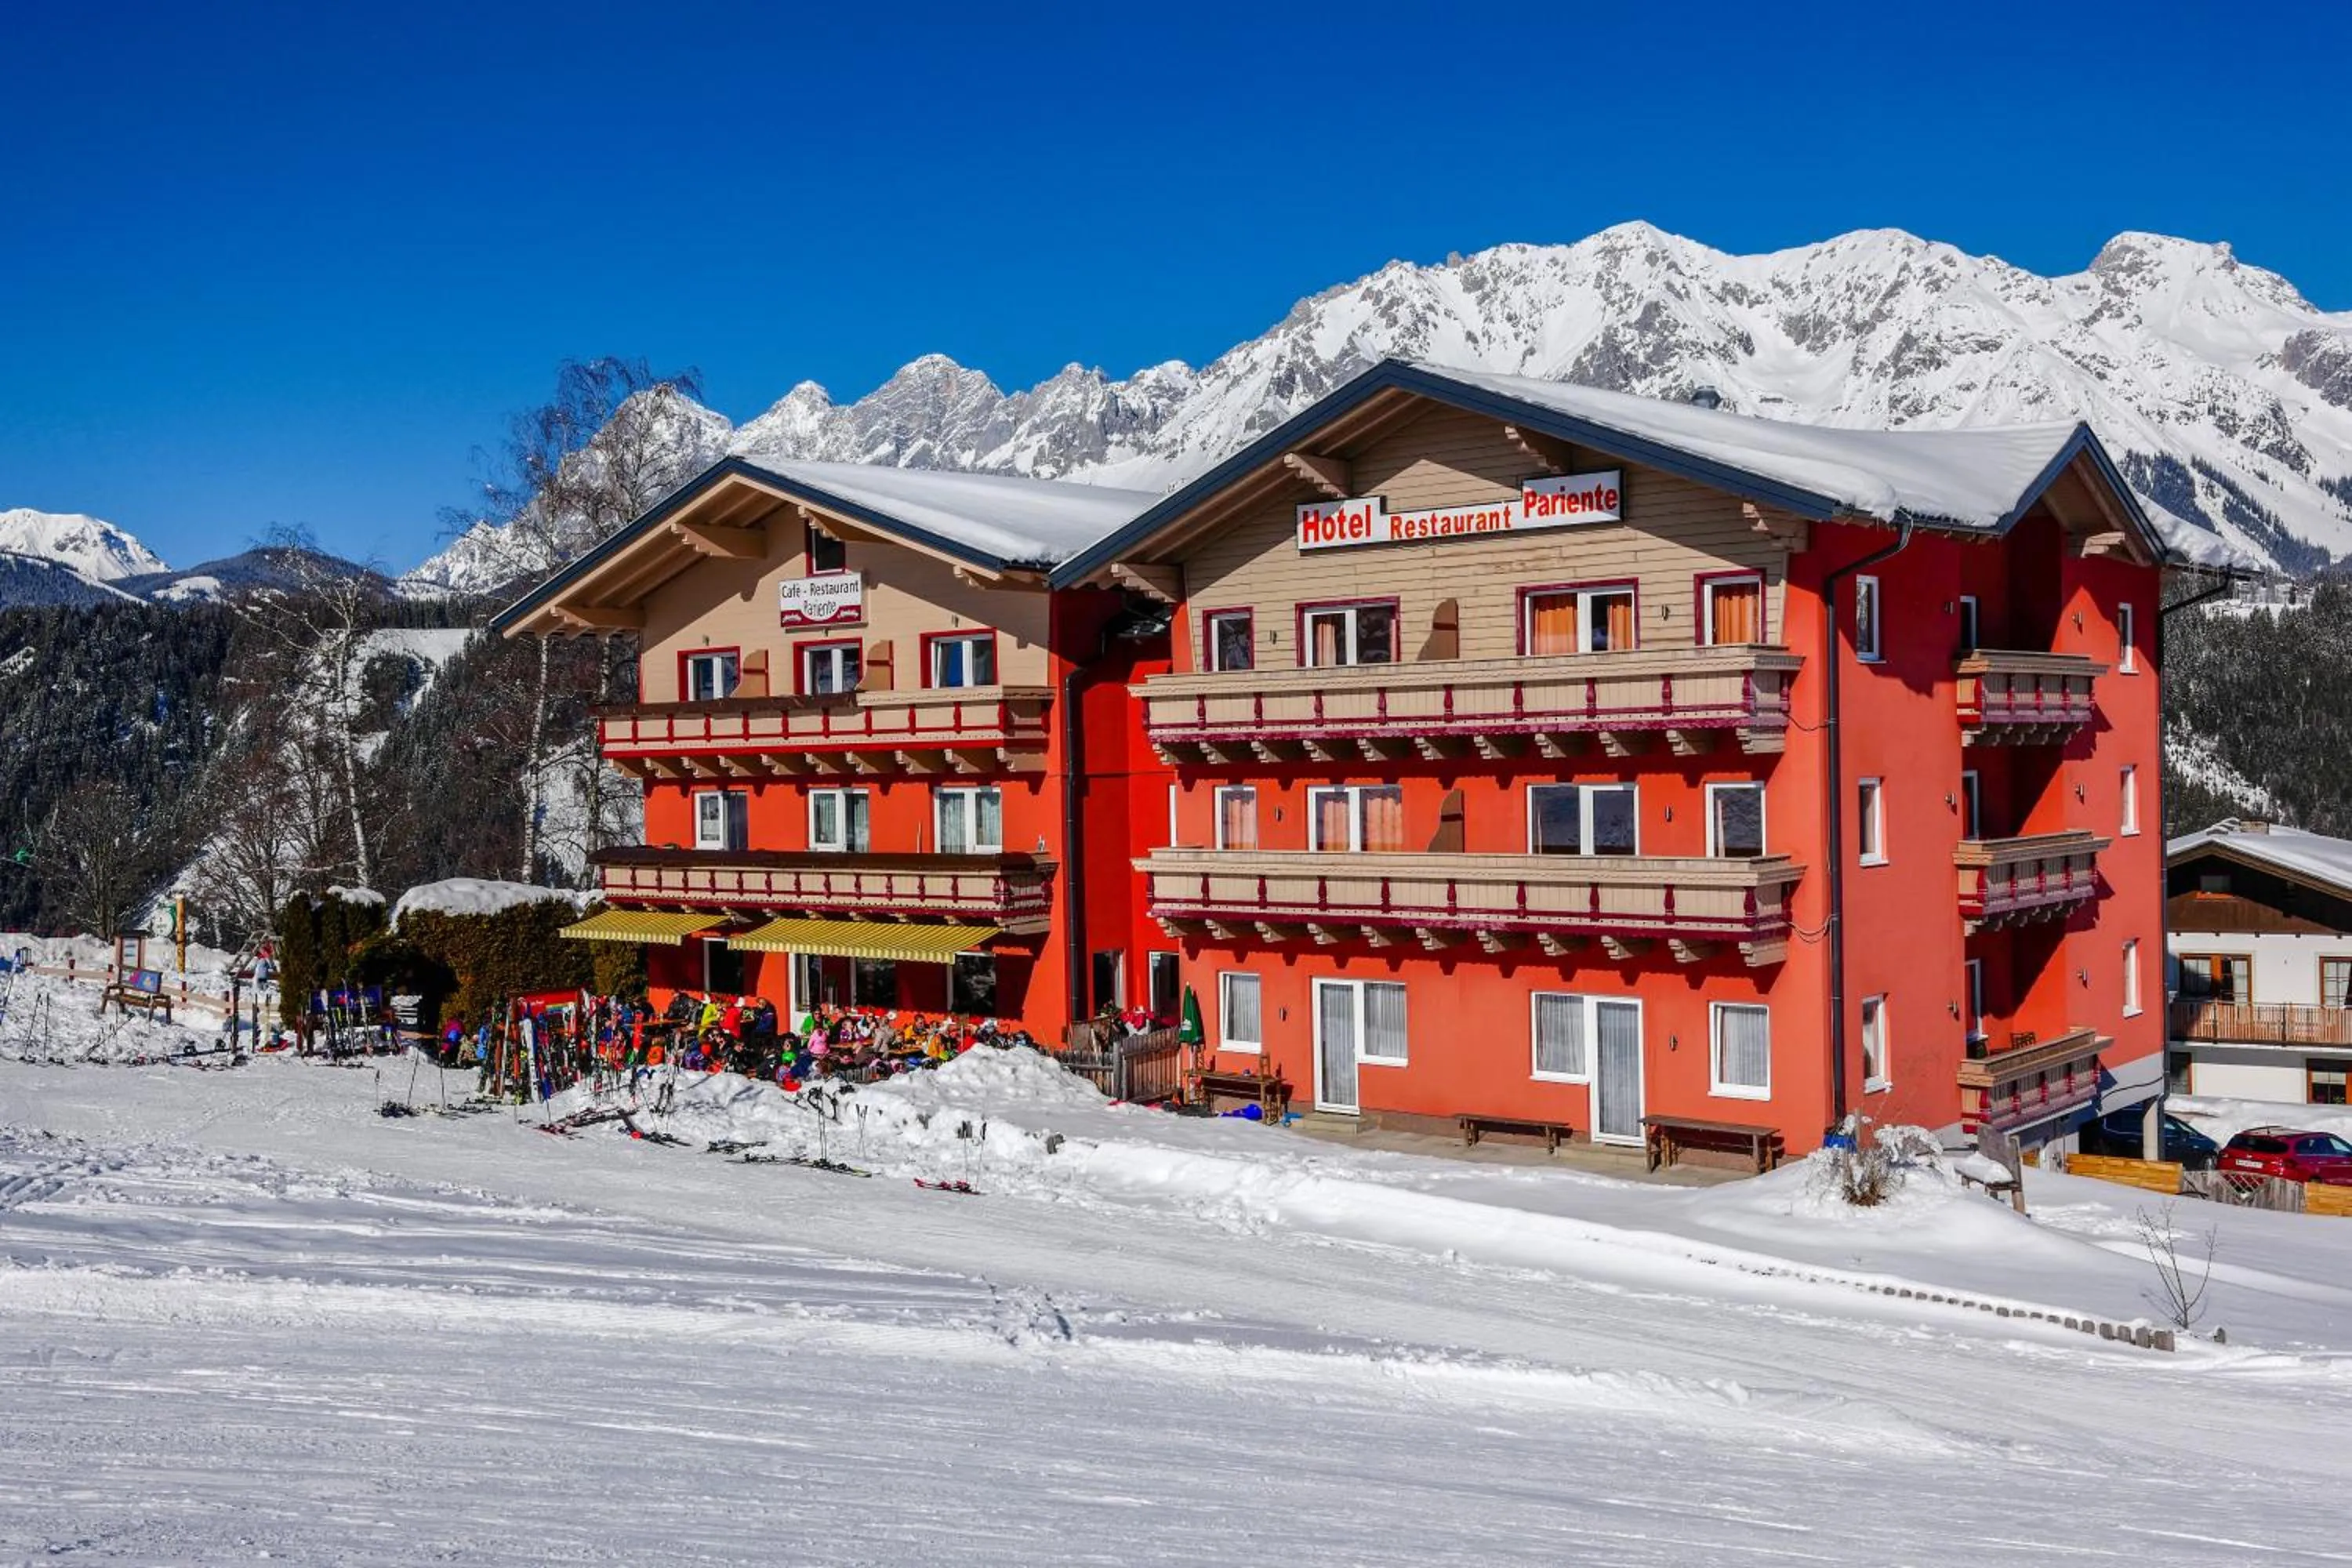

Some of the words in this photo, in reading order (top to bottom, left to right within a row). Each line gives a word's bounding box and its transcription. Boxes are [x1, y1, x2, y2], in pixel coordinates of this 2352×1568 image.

[1301, 504, 1372, 543] Hotel
[1389, 504, 1512, 540] Restaurant
[1523, 483, 1618, 518] Pariente
[810, 581, 858, 596] Restaurant
